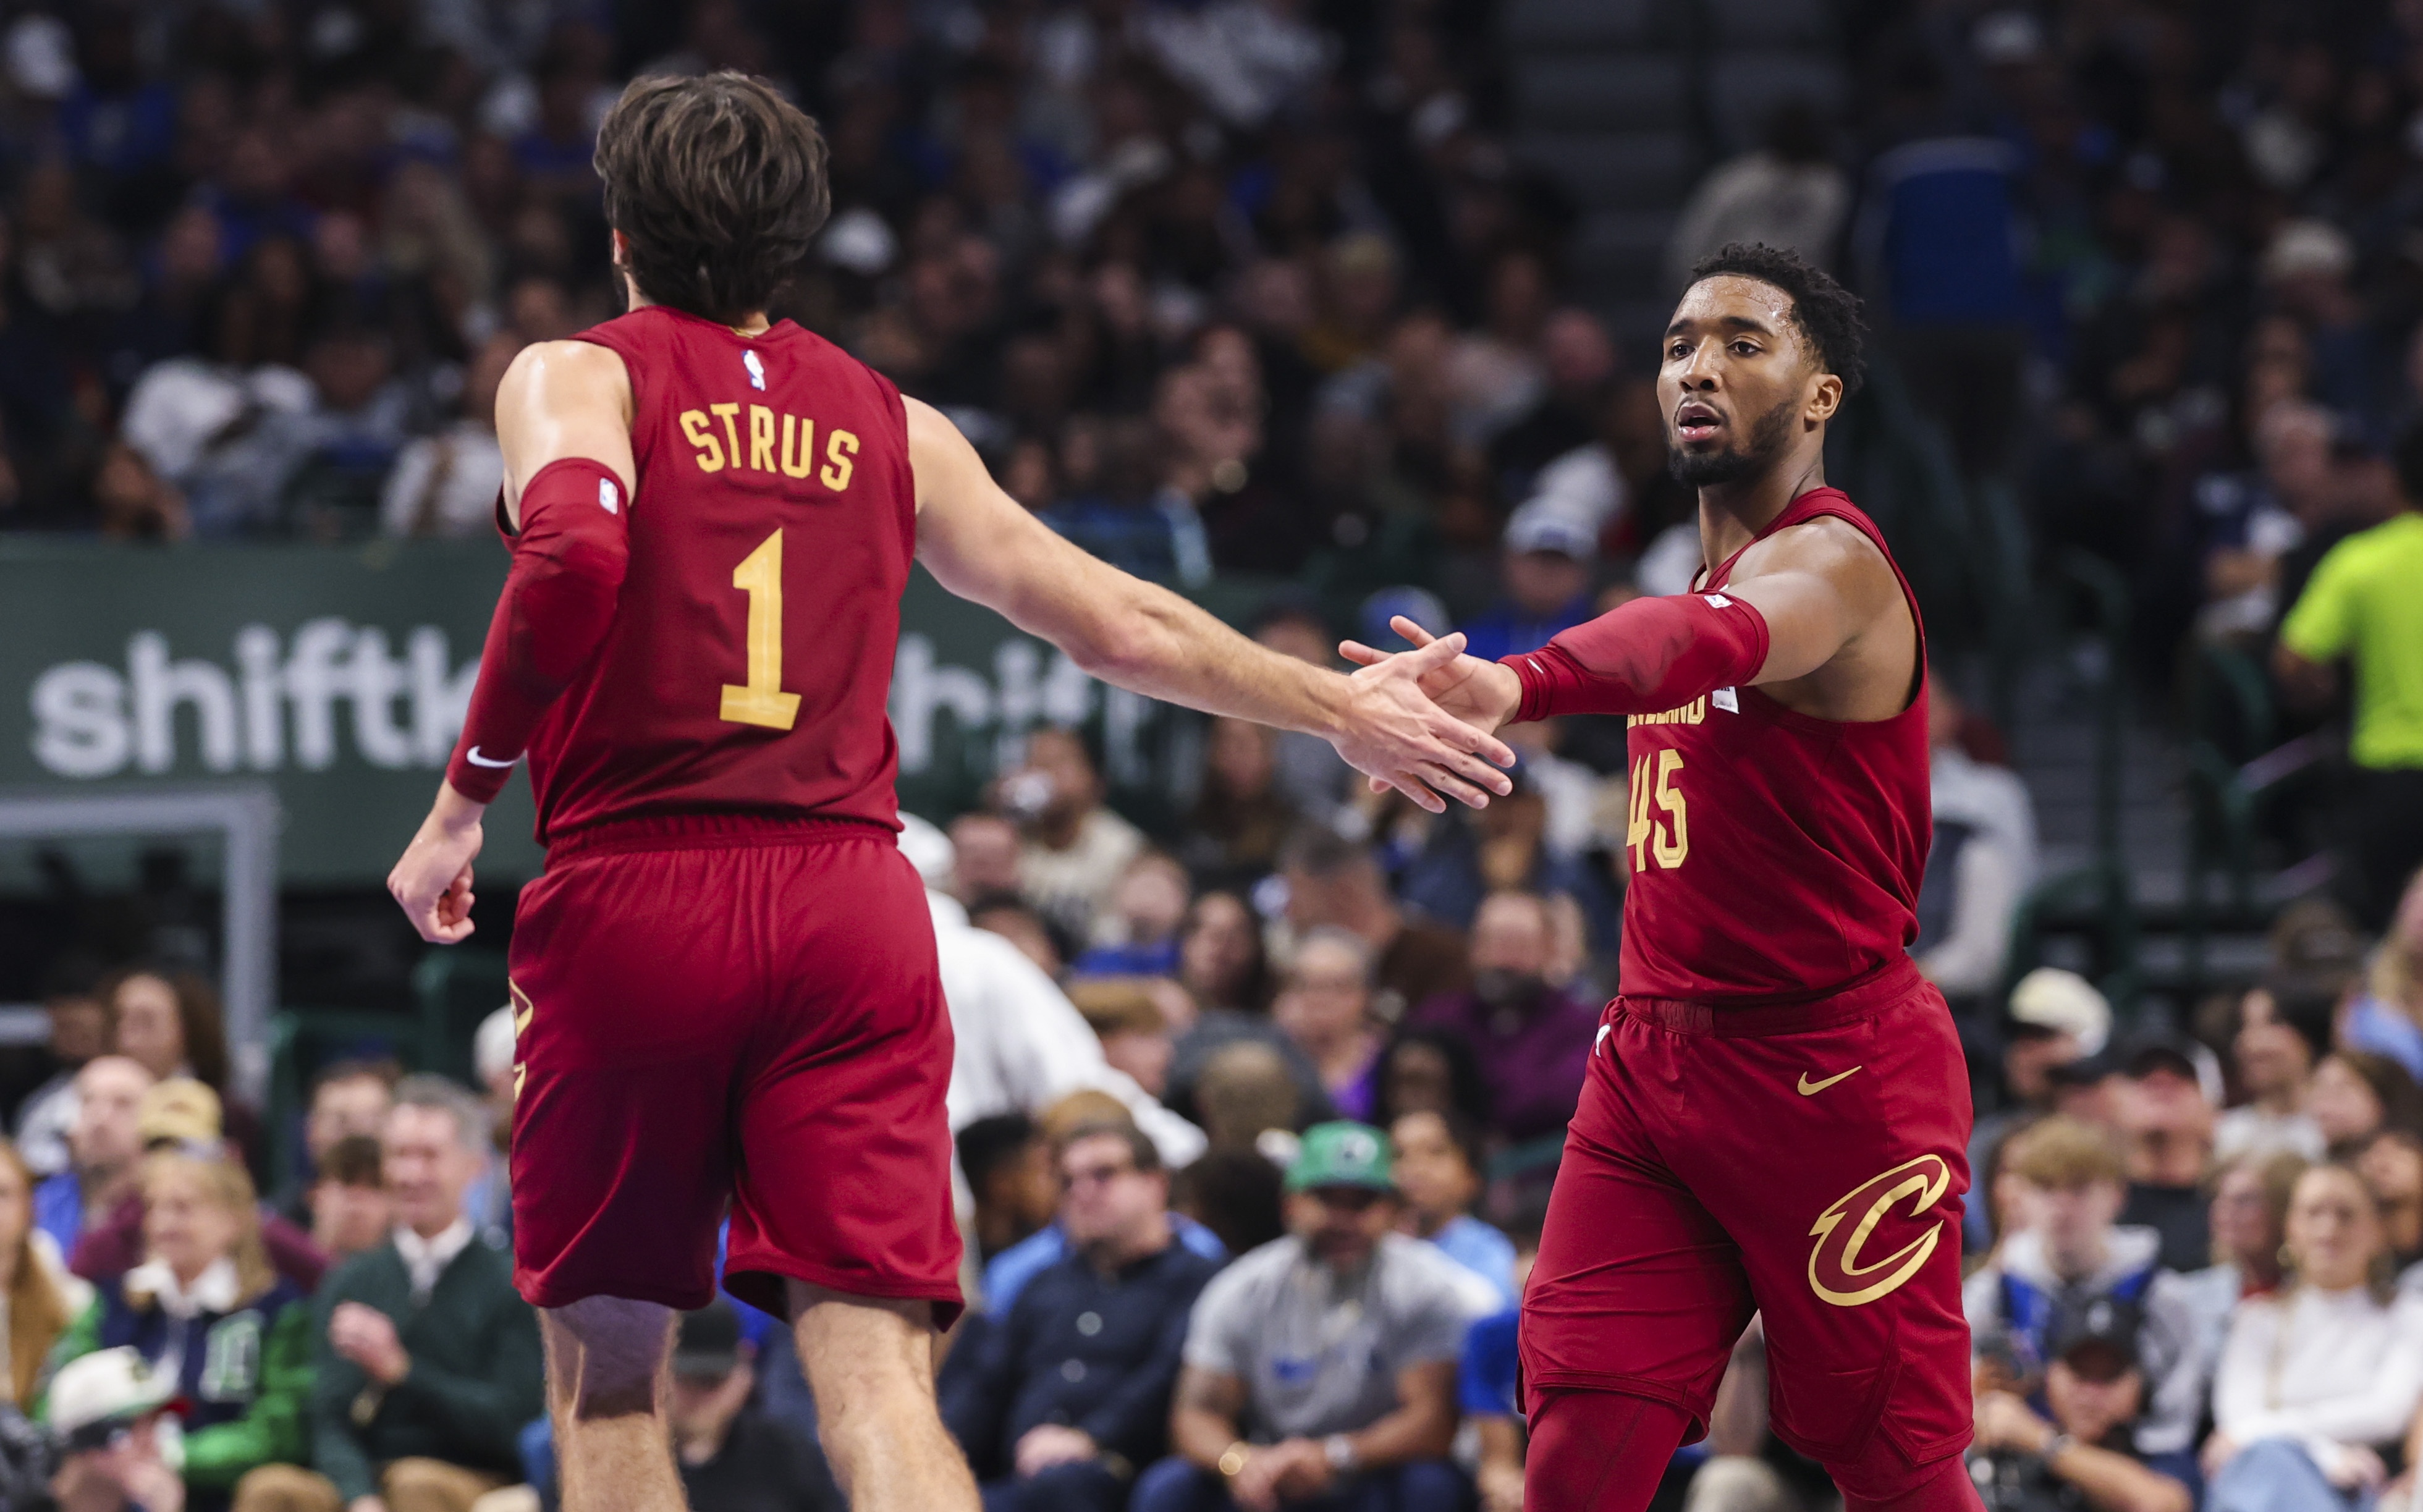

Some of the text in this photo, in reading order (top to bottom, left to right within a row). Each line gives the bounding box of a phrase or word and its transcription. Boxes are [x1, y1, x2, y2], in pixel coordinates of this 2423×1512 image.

[680, 402, 860, 492] STRUS
[30, 615, 488, 780] shiftk
[719, 527, 801, 730] 1
[1626, 748, 1689, 873] 45
